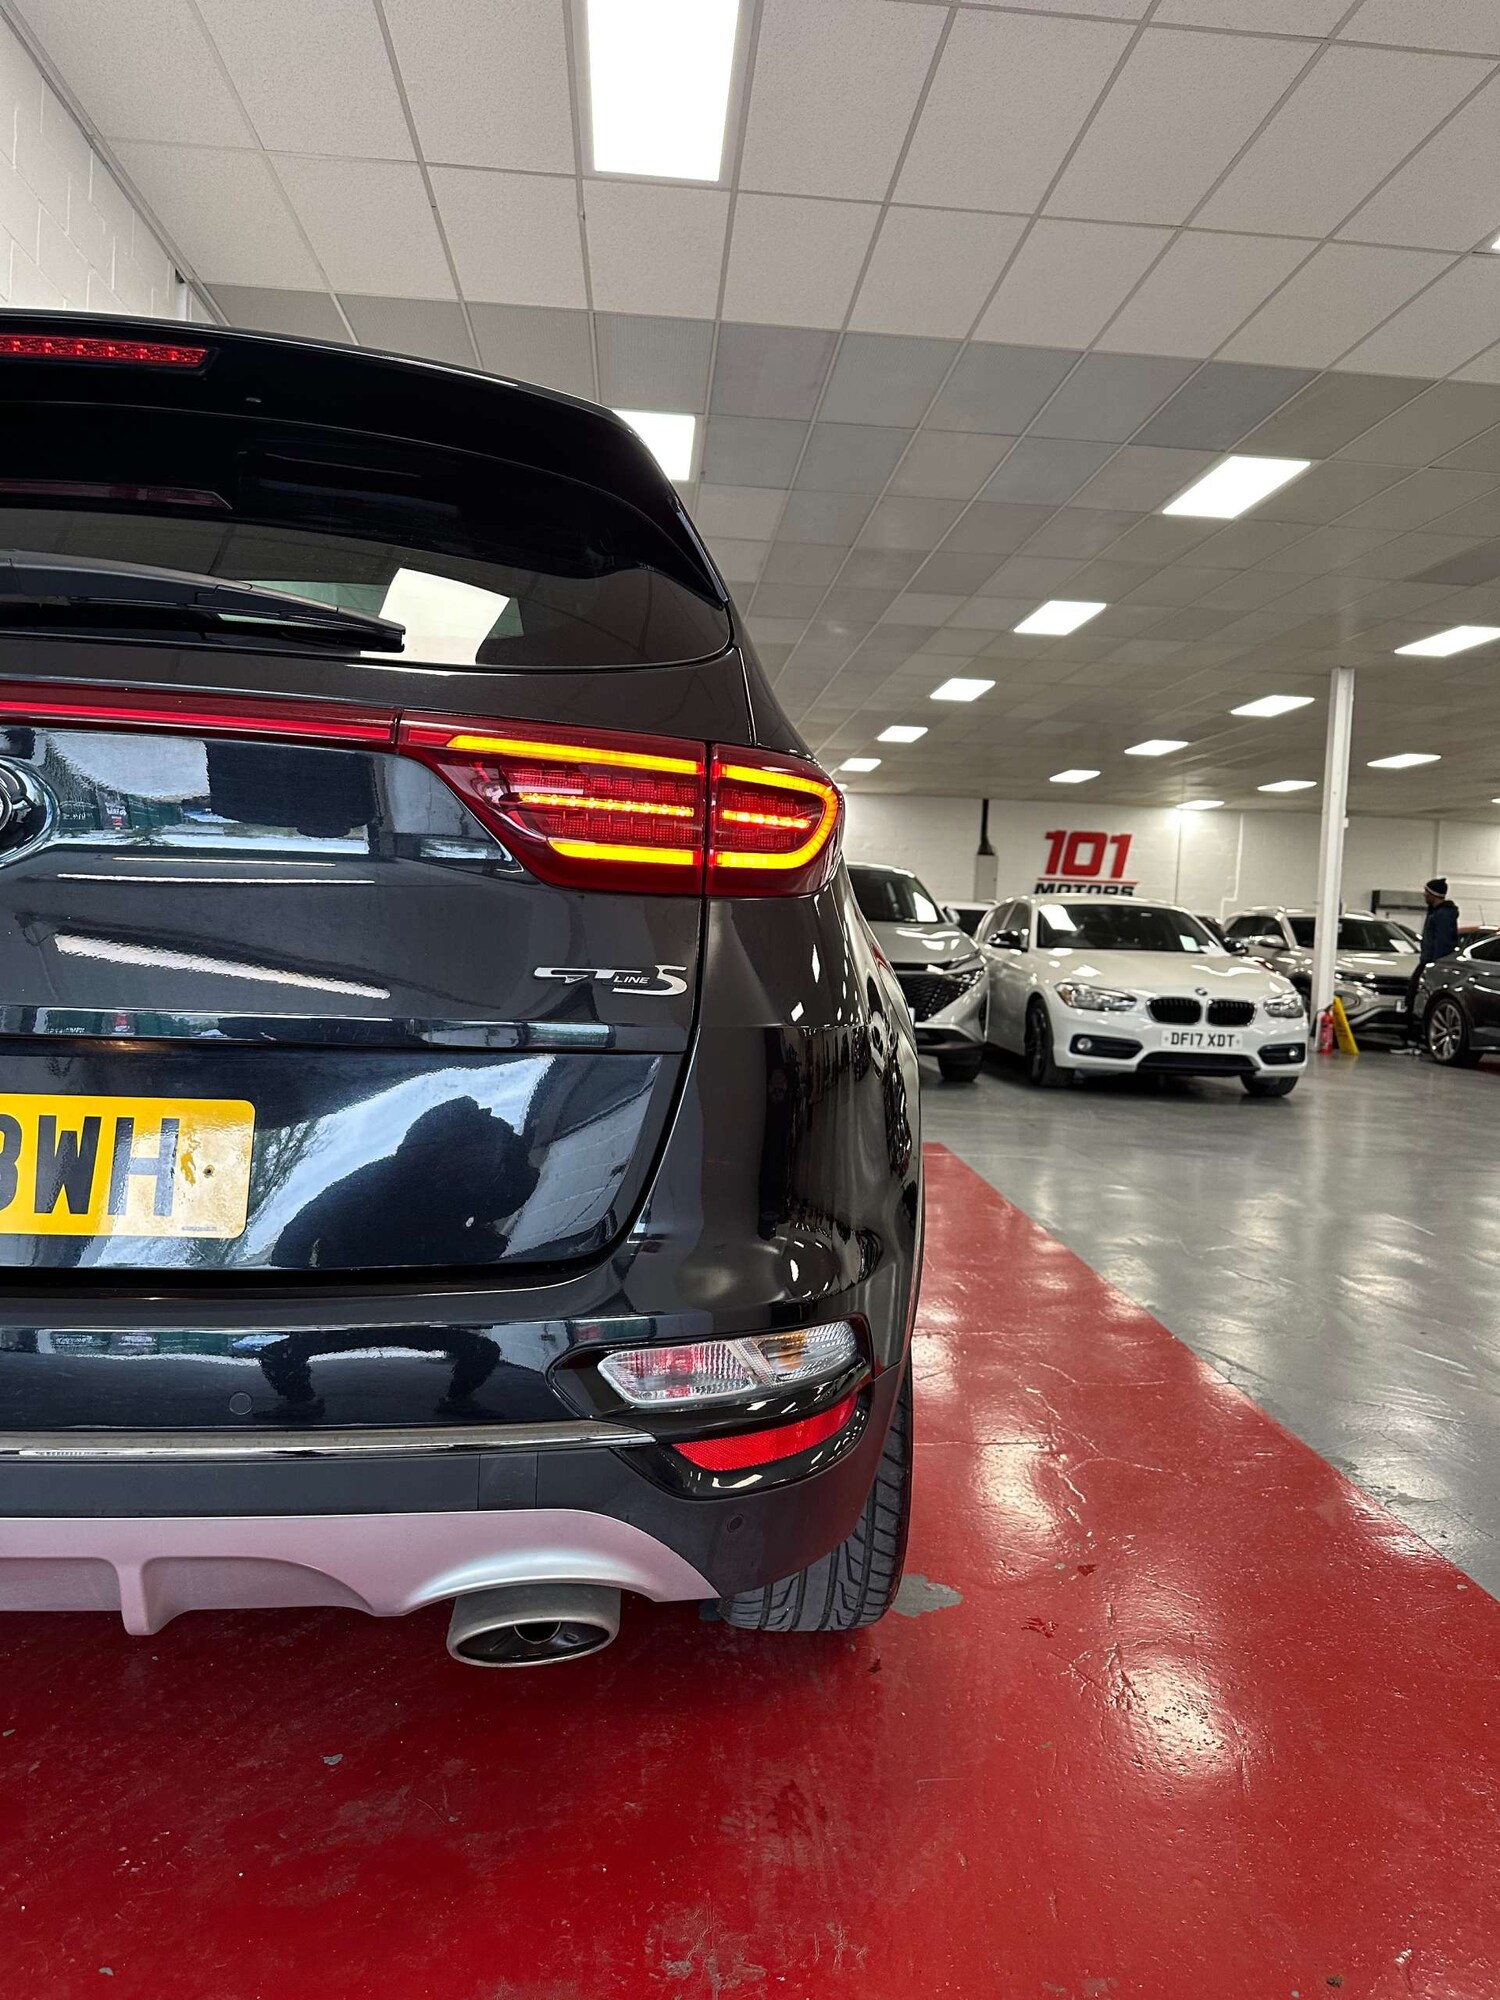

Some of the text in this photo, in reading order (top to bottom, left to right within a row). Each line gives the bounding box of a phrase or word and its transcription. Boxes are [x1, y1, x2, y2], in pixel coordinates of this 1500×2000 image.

[1044, 830, 1132, 879] 101
[613, 976, 650, 984] LINE
[1171, 1032, 1235, 1048] DF17 XDT
